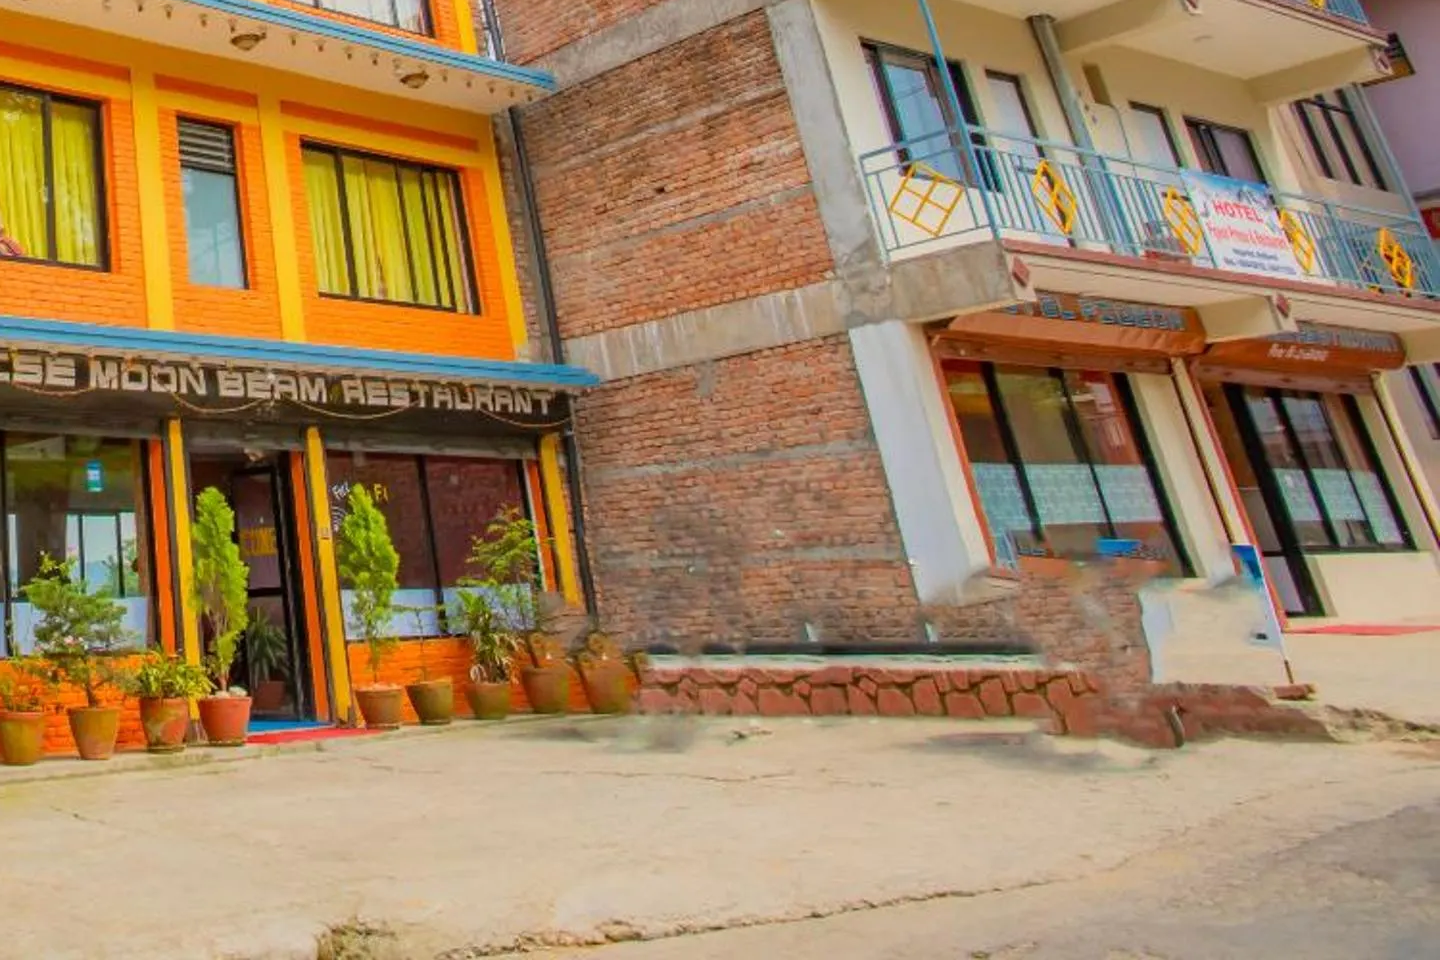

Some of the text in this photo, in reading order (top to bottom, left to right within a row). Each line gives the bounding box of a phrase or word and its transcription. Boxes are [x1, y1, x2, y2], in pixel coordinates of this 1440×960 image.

[1213, 199, 1264, 223] HOTEL
[89, 359, 208, 395] MOON
[216, 368, 328, 404] BEAM
[341, 378, 553, 416] RESTAURANT
